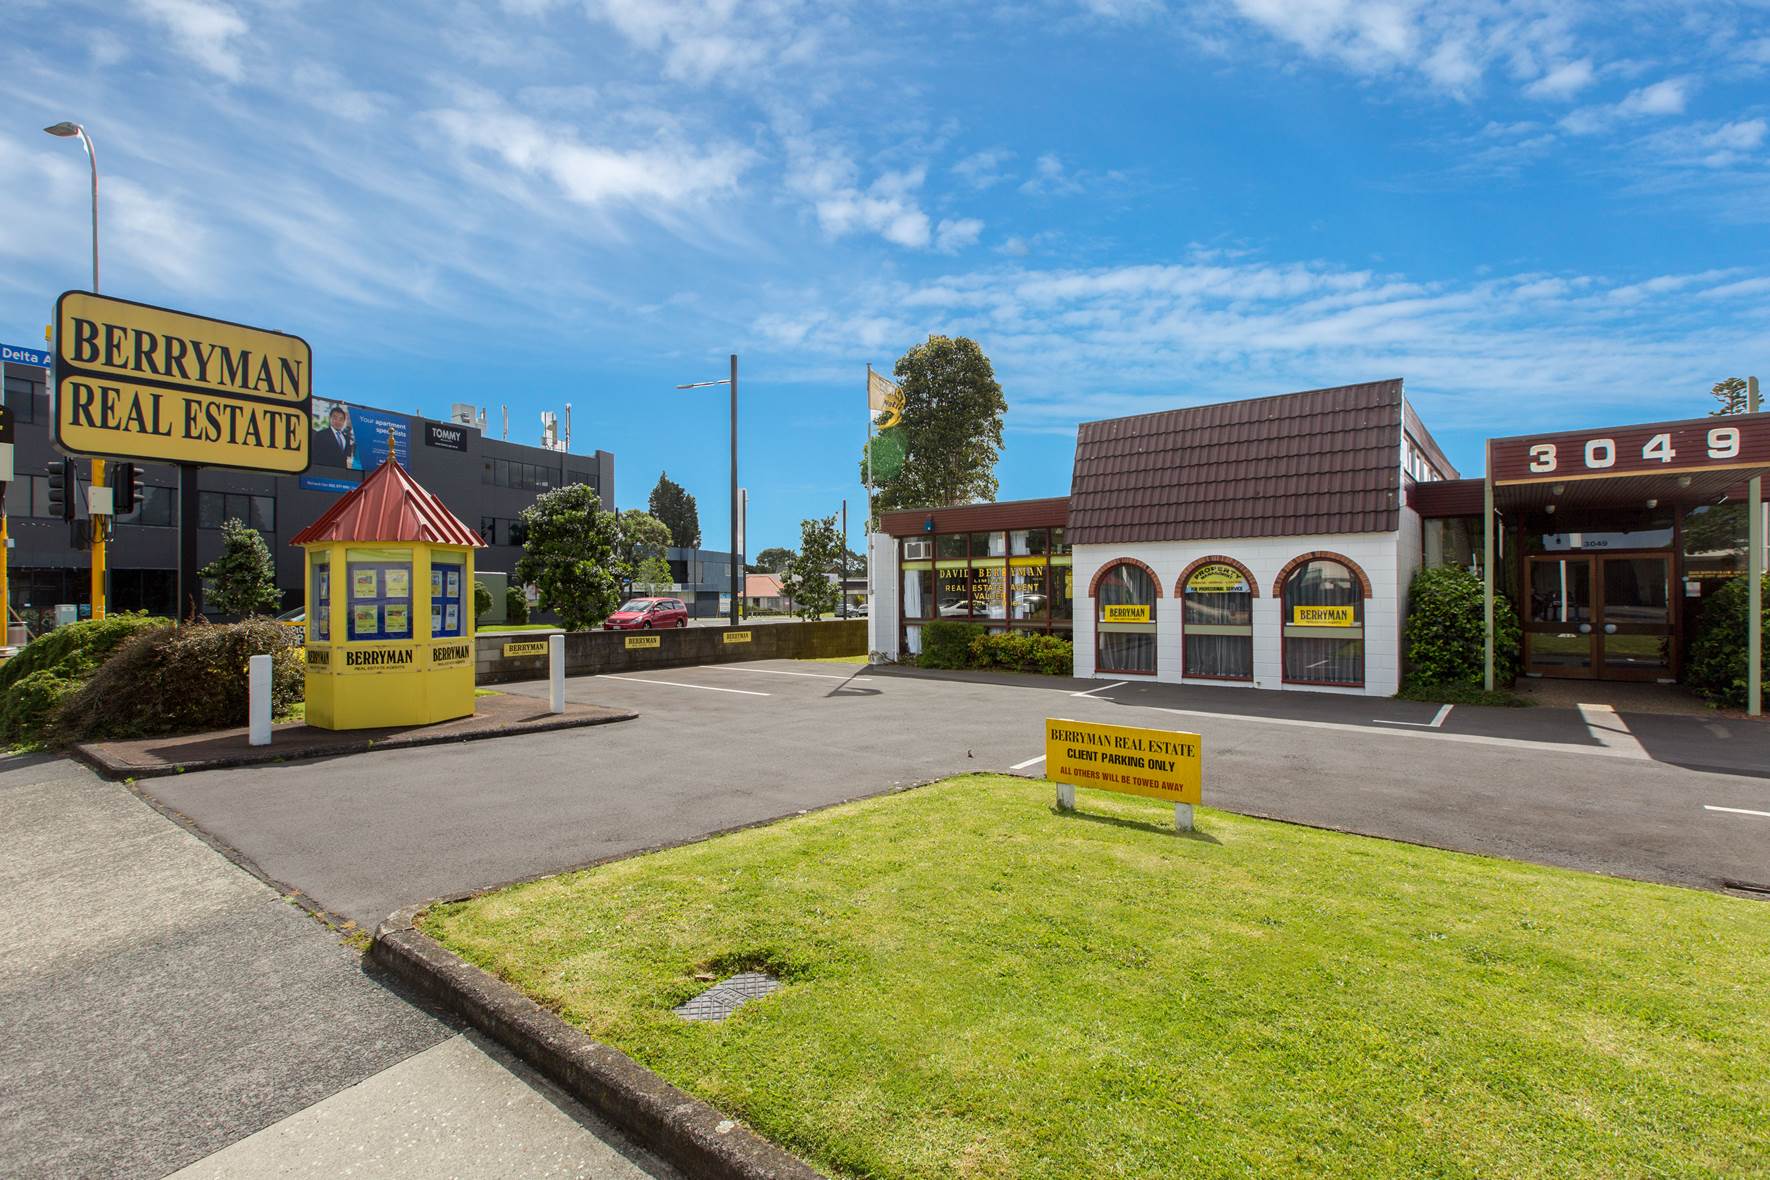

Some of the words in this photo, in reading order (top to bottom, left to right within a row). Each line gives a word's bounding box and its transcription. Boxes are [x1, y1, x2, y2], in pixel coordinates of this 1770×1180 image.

[2, 347, 38, 363] Delta
[70, 317, 302, 398] BERRYMAN
[69, 382, 172, 436] REAL
[181, 398, 302, 451] ESTATE
[360, 415, 374, 424] Your
[375, 420, 406, 430] apartment
[432, 427, 461, 441] TOMMY
[940, 568, 969, 578] DAVID
[978, 566, 1044, 577] BERRYMAN
[1194, 566, 1241, 579] PROPERTY
[972, 584, 1004, 592] ESTATE
[1010, 583, 1039, 592] AGENT
[1109, 607, 1145, 617] BERRYMAN
[1300, 609, 1347, 620] BERRYMAN
[433, 645, 469, 662] BERRYMAN
[508, 643, 544, 652] BERRYMAN
[346, 649, 413, 665] BERRYMAN
[1051, 729, 1111, 747] BERRYMAN
[1114, 736, 1145, 752] REAL
[1149, 740, 1195, 757] ESTATE
[1067, 748, 1098, 761] CLIENT
[1101, 753, 1144, 768] PARKING
[1148, 758, 1175, 772] ONLY
[1060, 766, 1072, 775] ALL
[1074, 768, 1100, 779] OTHERS
[1102, 773, 1119, 783] WILL
[1121, 775, 1130, 784] BE
[1133, 777, 1159, 789] TOWED
[1161, 783, 1184, 792] AWAY
